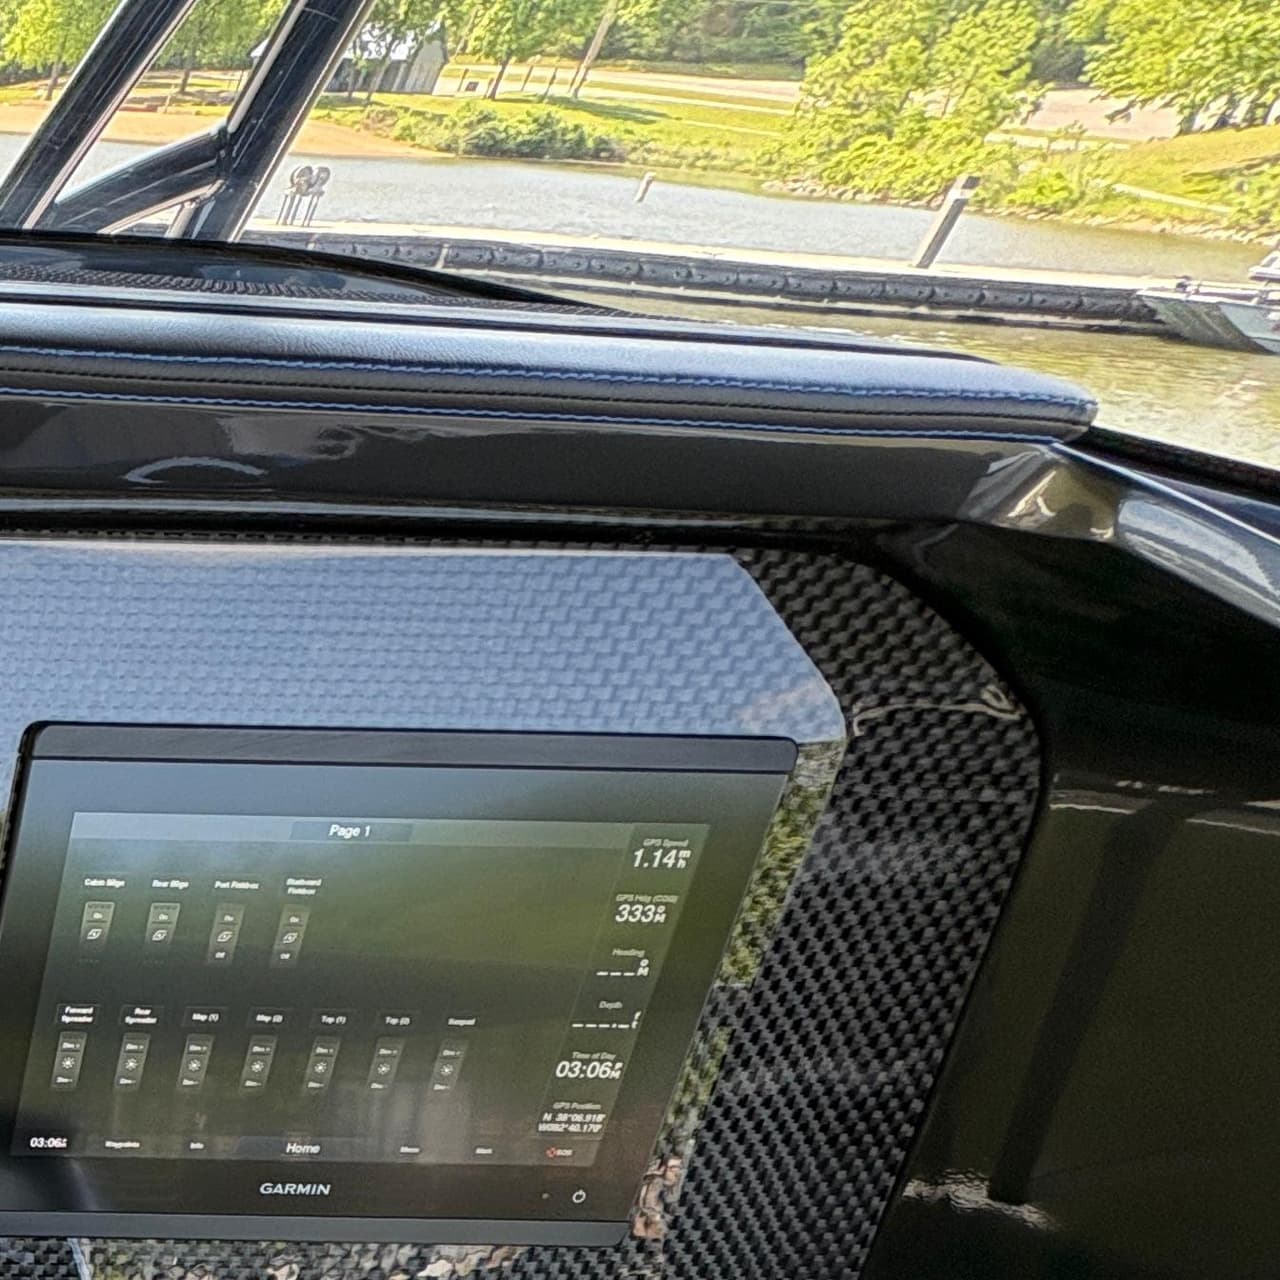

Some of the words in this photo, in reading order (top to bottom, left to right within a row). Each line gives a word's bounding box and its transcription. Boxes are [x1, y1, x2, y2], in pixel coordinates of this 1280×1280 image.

[328, 824, 360, 839] Page
[365, 825, 371, 837] 1
[633, 848, 677, 868] 1.14
[615, 904, 656, 922] 333
[555, 1061, 612, 1078] 03:06
[286, 1142, 321, 1154] Home
[259, 1183, 331, 1196] GARMIN
